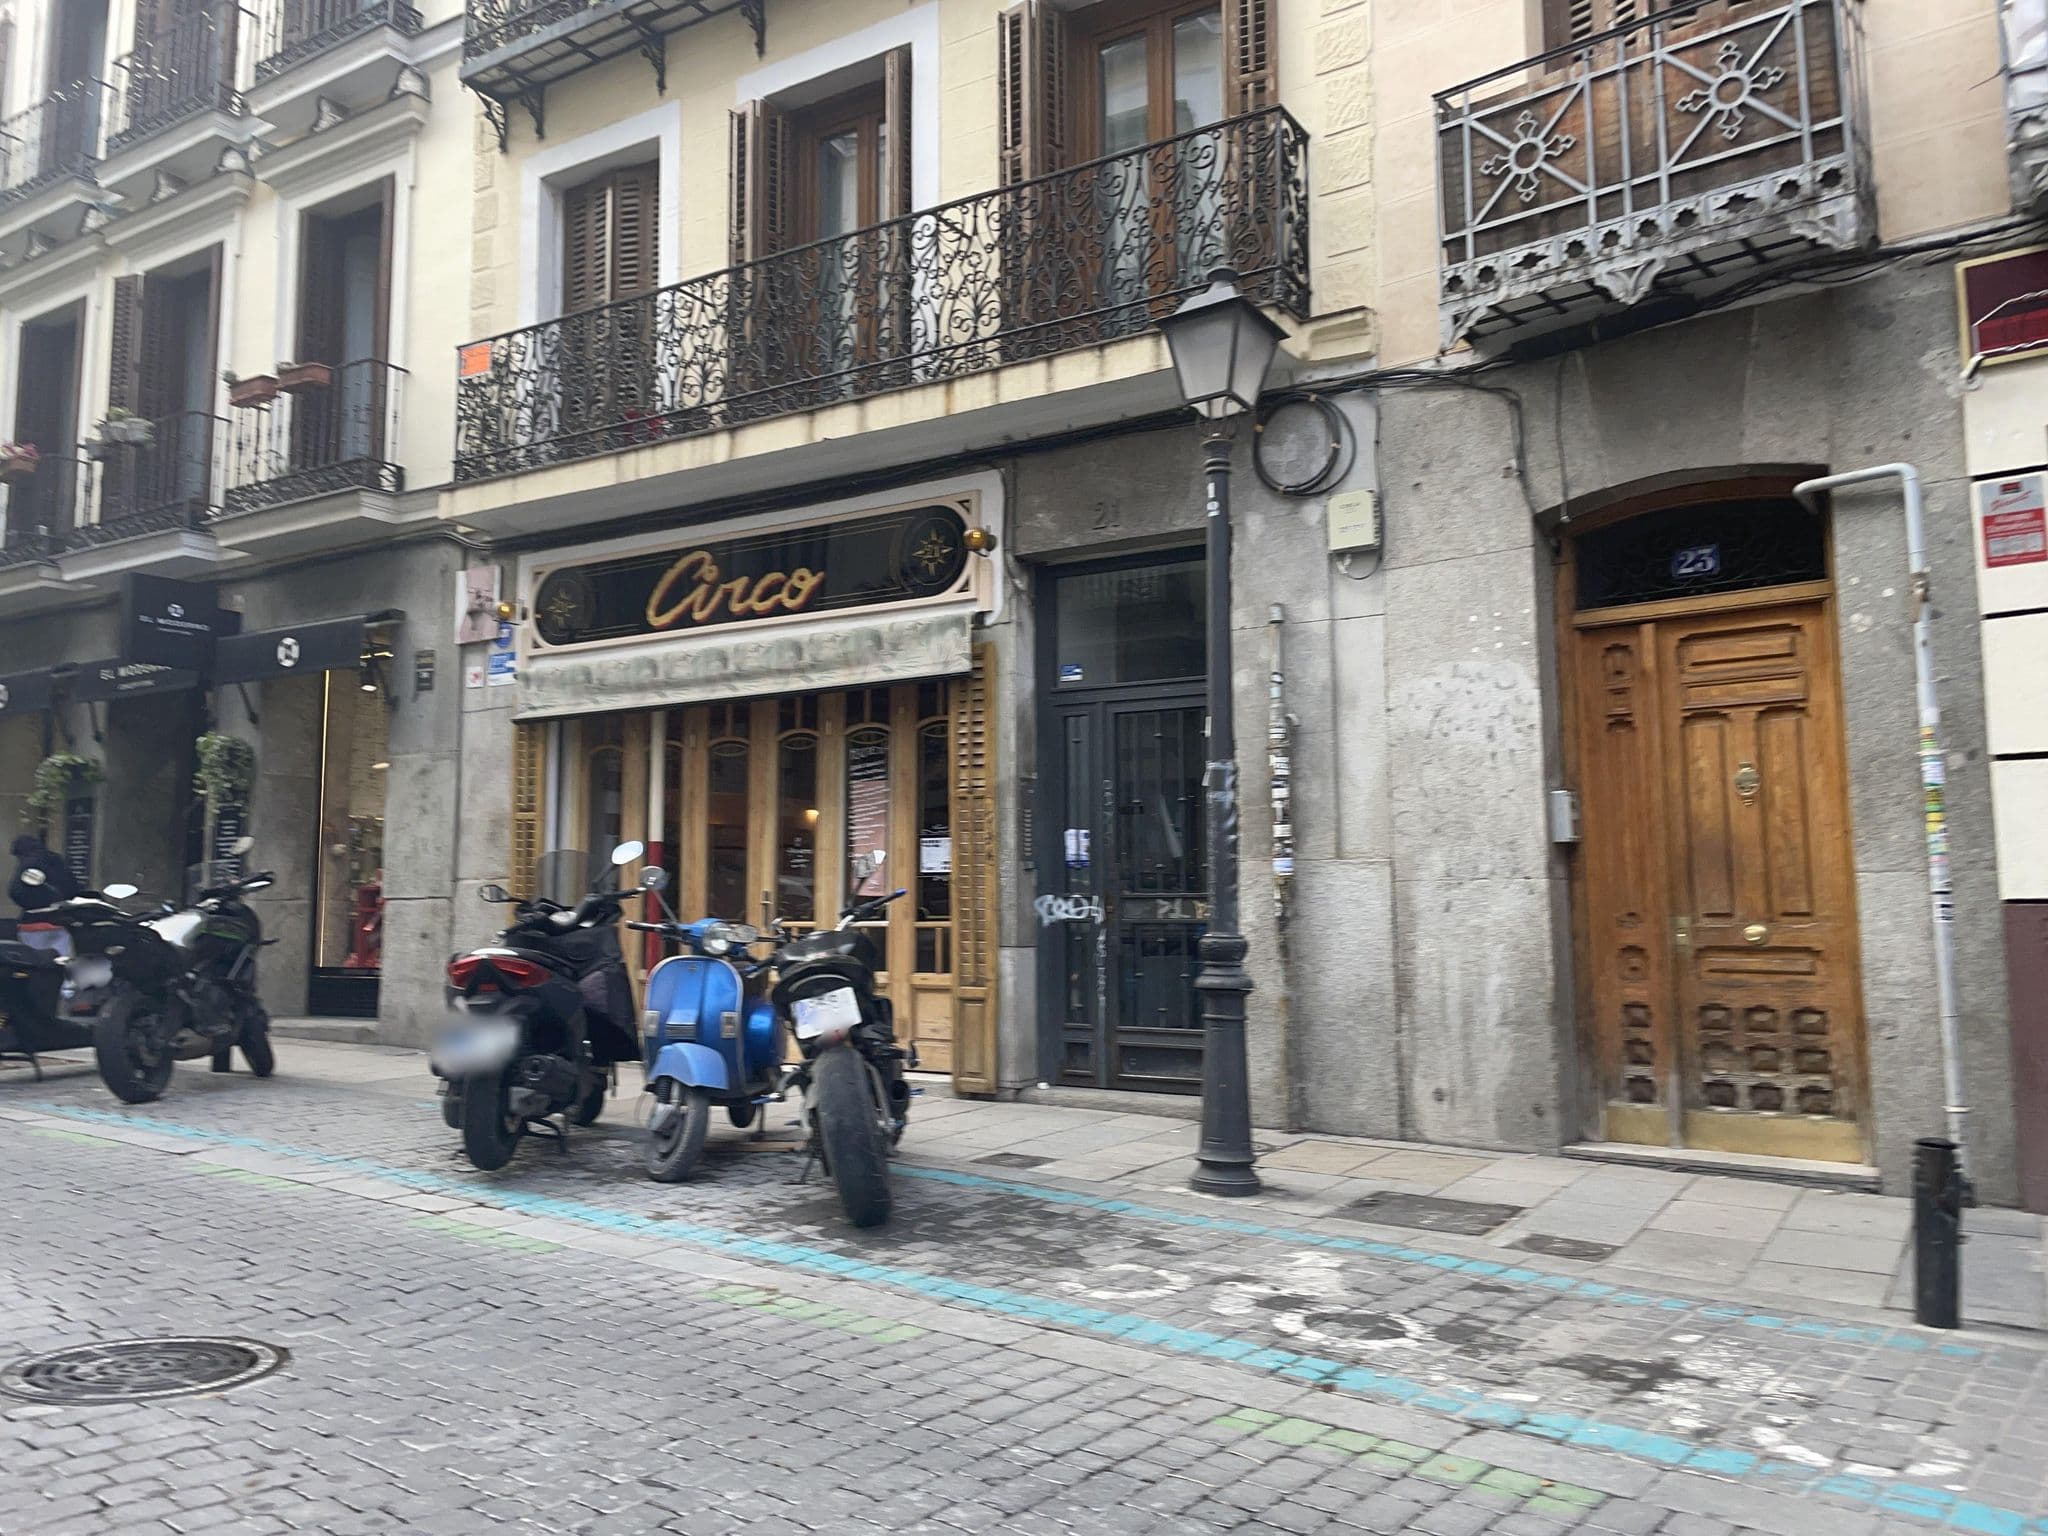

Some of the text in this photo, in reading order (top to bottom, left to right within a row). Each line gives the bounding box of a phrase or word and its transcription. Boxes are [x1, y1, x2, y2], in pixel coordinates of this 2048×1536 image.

[1091, 501, 1121, 530] 21
[1677, 548, 1714, 575] 23
[645, 549, 827, 630] Circo
